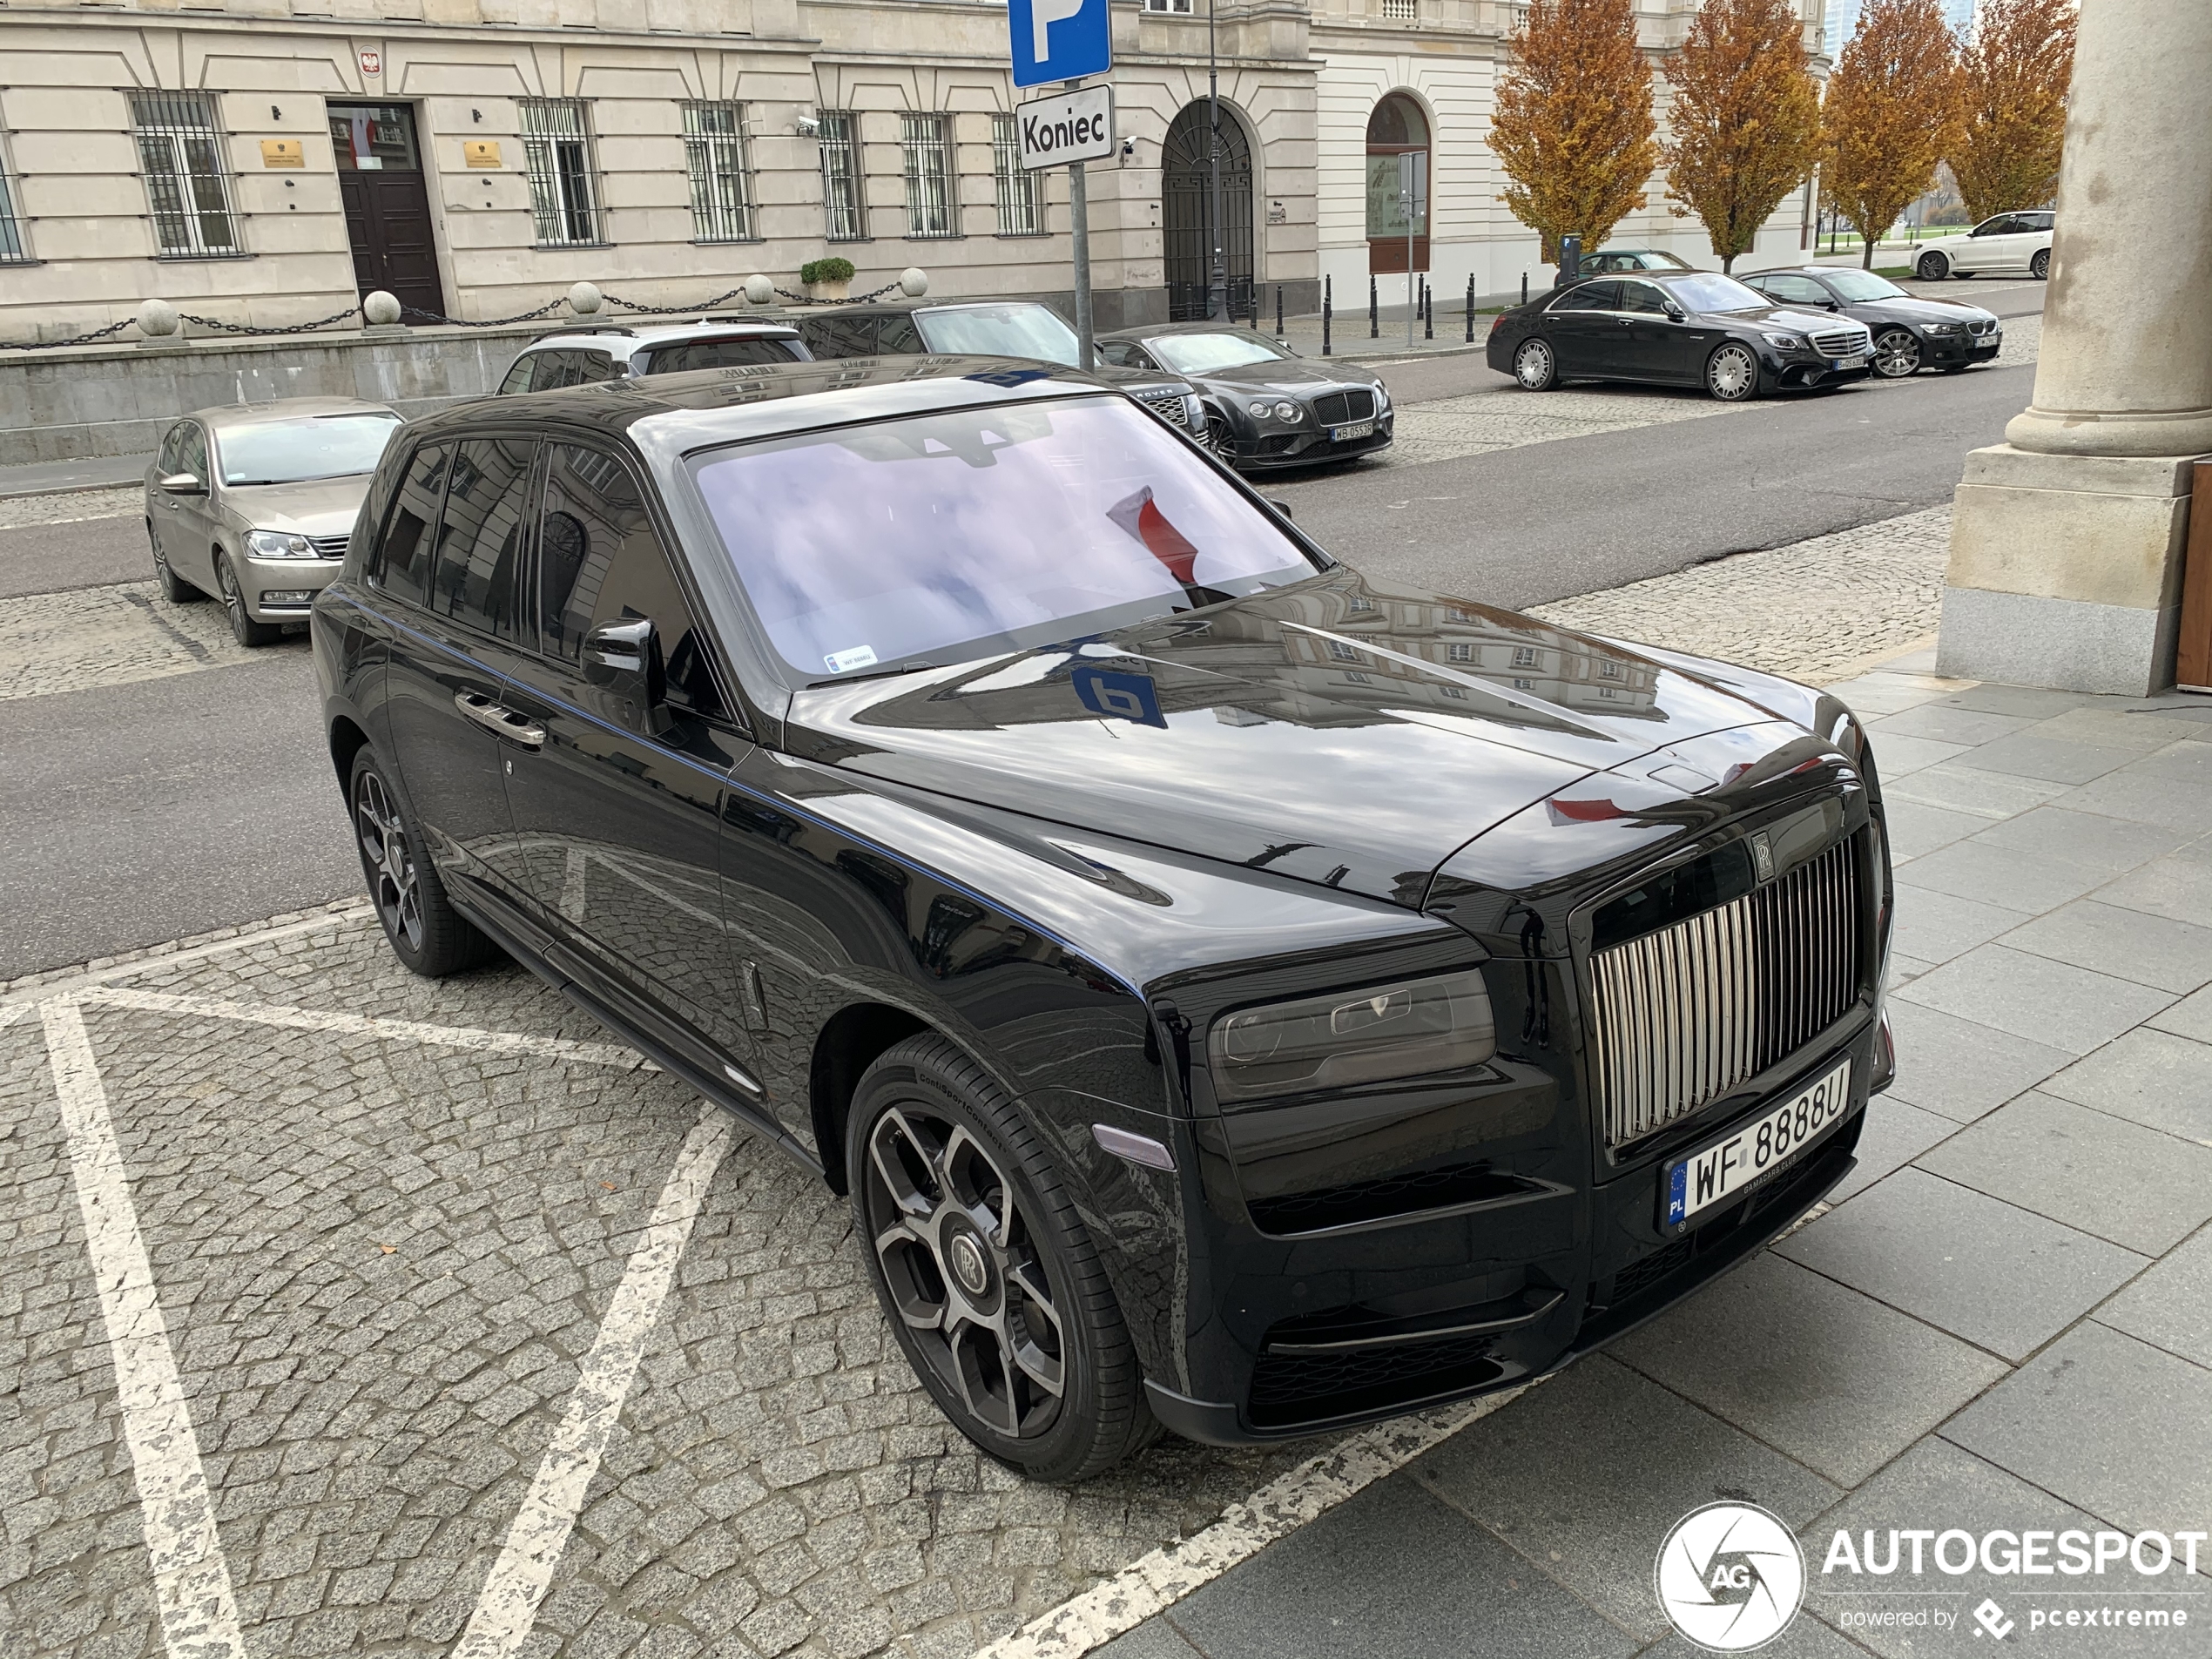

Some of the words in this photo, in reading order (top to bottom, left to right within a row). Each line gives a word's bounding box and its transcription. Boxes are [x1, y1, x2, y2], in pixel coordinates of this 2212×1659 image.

[1023, 107, 1105, 154] Koniec
[1564, 238, 1570, 247] P
[1136, 388, 1173, 399] ROVER
[1336, 428, 1348, 440] WB
[1350, 423, 1372, 437] 0553R
[1696, 1136, 1743, 1206] WF
[1754, 1067, 1845, 1169] 8888U
[1743, 1154, 1797, 1194] GAMACARS.CLUB
[1669, 1198, 1683, 1216] PL
